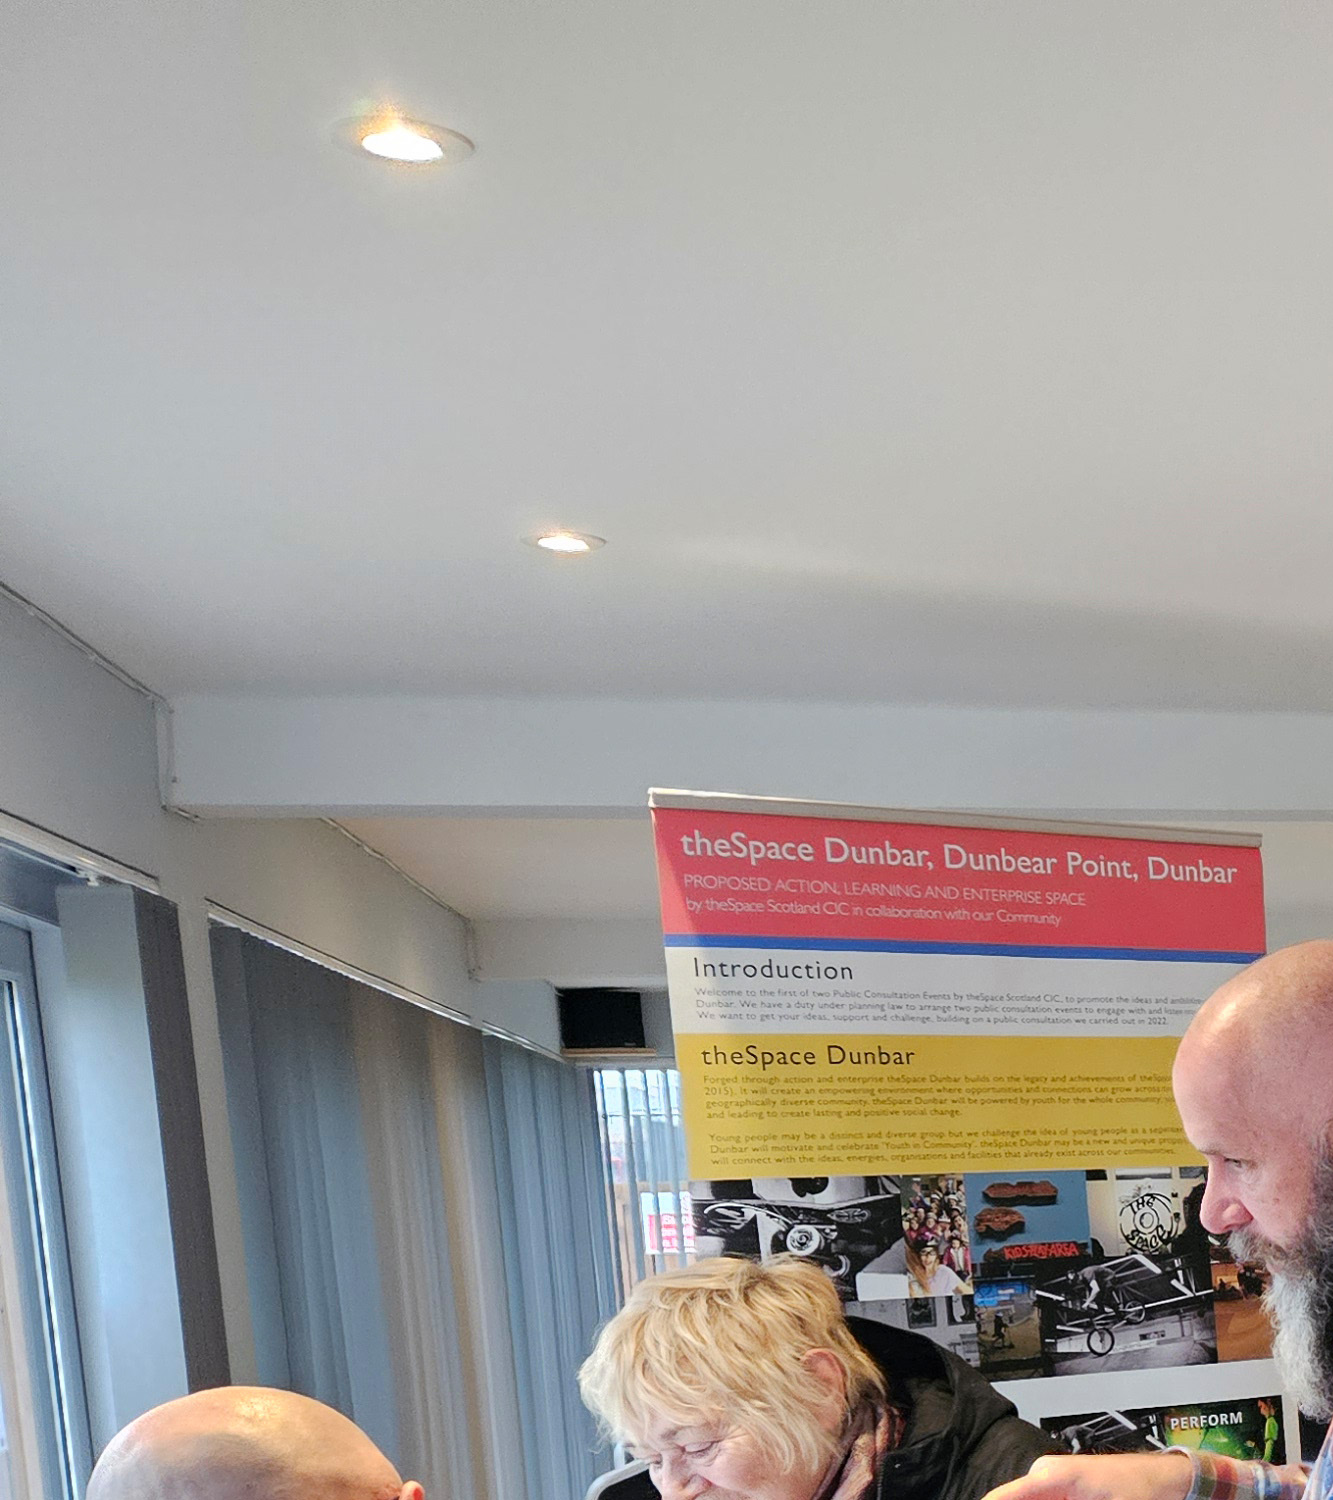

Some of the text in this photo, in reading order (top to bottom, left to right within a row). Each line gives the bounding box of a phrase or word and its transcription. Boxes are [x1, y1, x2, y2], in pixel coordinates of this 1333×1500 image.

[681, 830, 1237, 883] theSpace Dunbar, Dunbear Point, Dunbar
[684, 874, 771, 891] PROPOSED
[844, 883, 922, 898] LEARNING
[925, 886, 959, 899] AND
[963, 888, 1043, 904] ENTERPRISE
[1046, 892, 1086, 906] SPACE
[706, 898, 765, 913] theSpace
[767, 900, 820, 915] Scotland
[823, 903, 849, 916] CIC
[853, 904, 863, 915] in
[996, 910, 1061, 928] Community
[694, 958, 853, 980] Introduction
[701, 1045, 915, 1071] theSpace Dunbar
[1170, 1412, 1243, 1430] PERFORM
